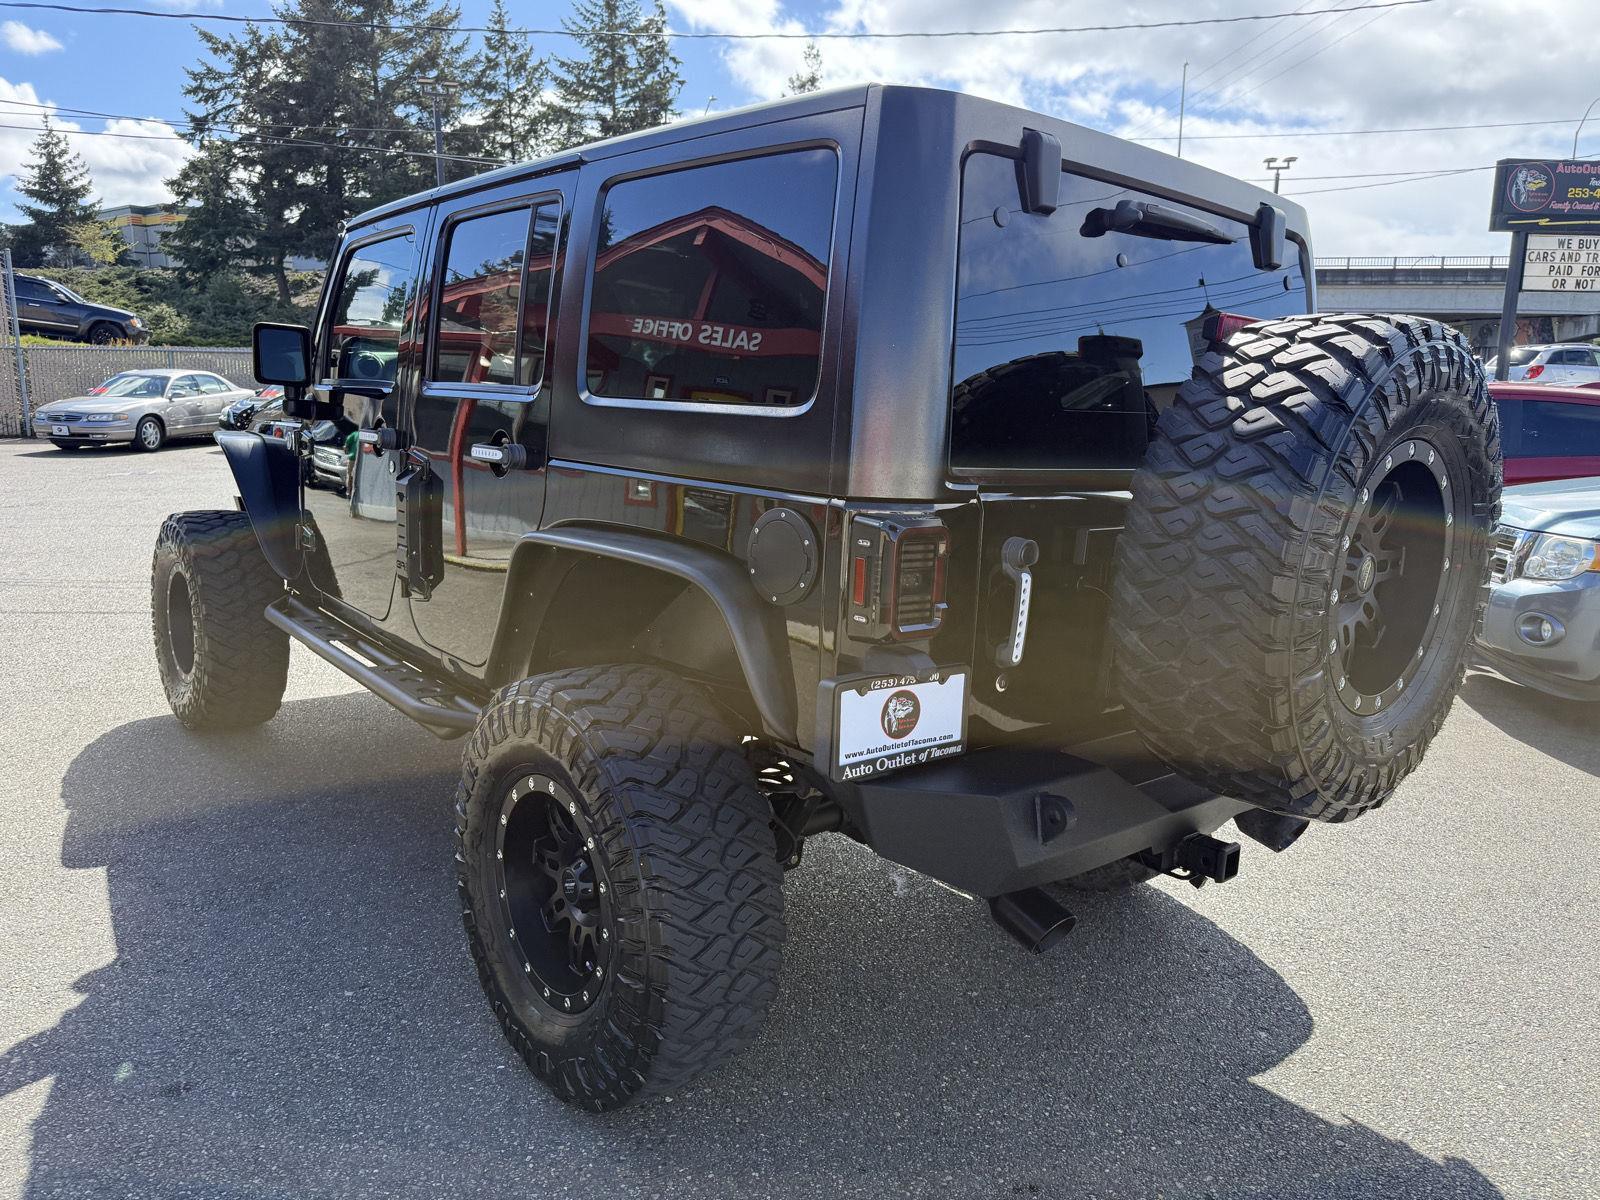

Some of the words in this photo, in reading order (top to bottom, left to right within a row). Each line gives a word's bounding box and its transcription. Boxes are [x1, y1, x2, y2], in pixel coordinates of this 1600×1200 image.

[1549, 200, 1571, 213] Family
[1572, 201, 1595, 210] Owned
[1558, 238, 1573, 249] WE
[1578, 239, 1600, 249] BUY
[1528, 251, 1556, 262] CARS
[1560, 252, 1581, 262] AND
[1586, 252, 1600, 263] TR
[1548, 265, 1573, 276] PAID
[1581, 266, 1600, 276] FOR
[1552, 279, 1567, 289] OR
[1574, 279, 1596, 290] NOT
[870, 677, 898, 690] (253)
[844, 733, 954, 759] www.AutoOutletofTacoma.com
[841, 764, 873, 780] Auto
[876, 753, 917, 771] Outlet
[918, 748, 931, 762] of
[930, 744, 962, 758] Tacoma
